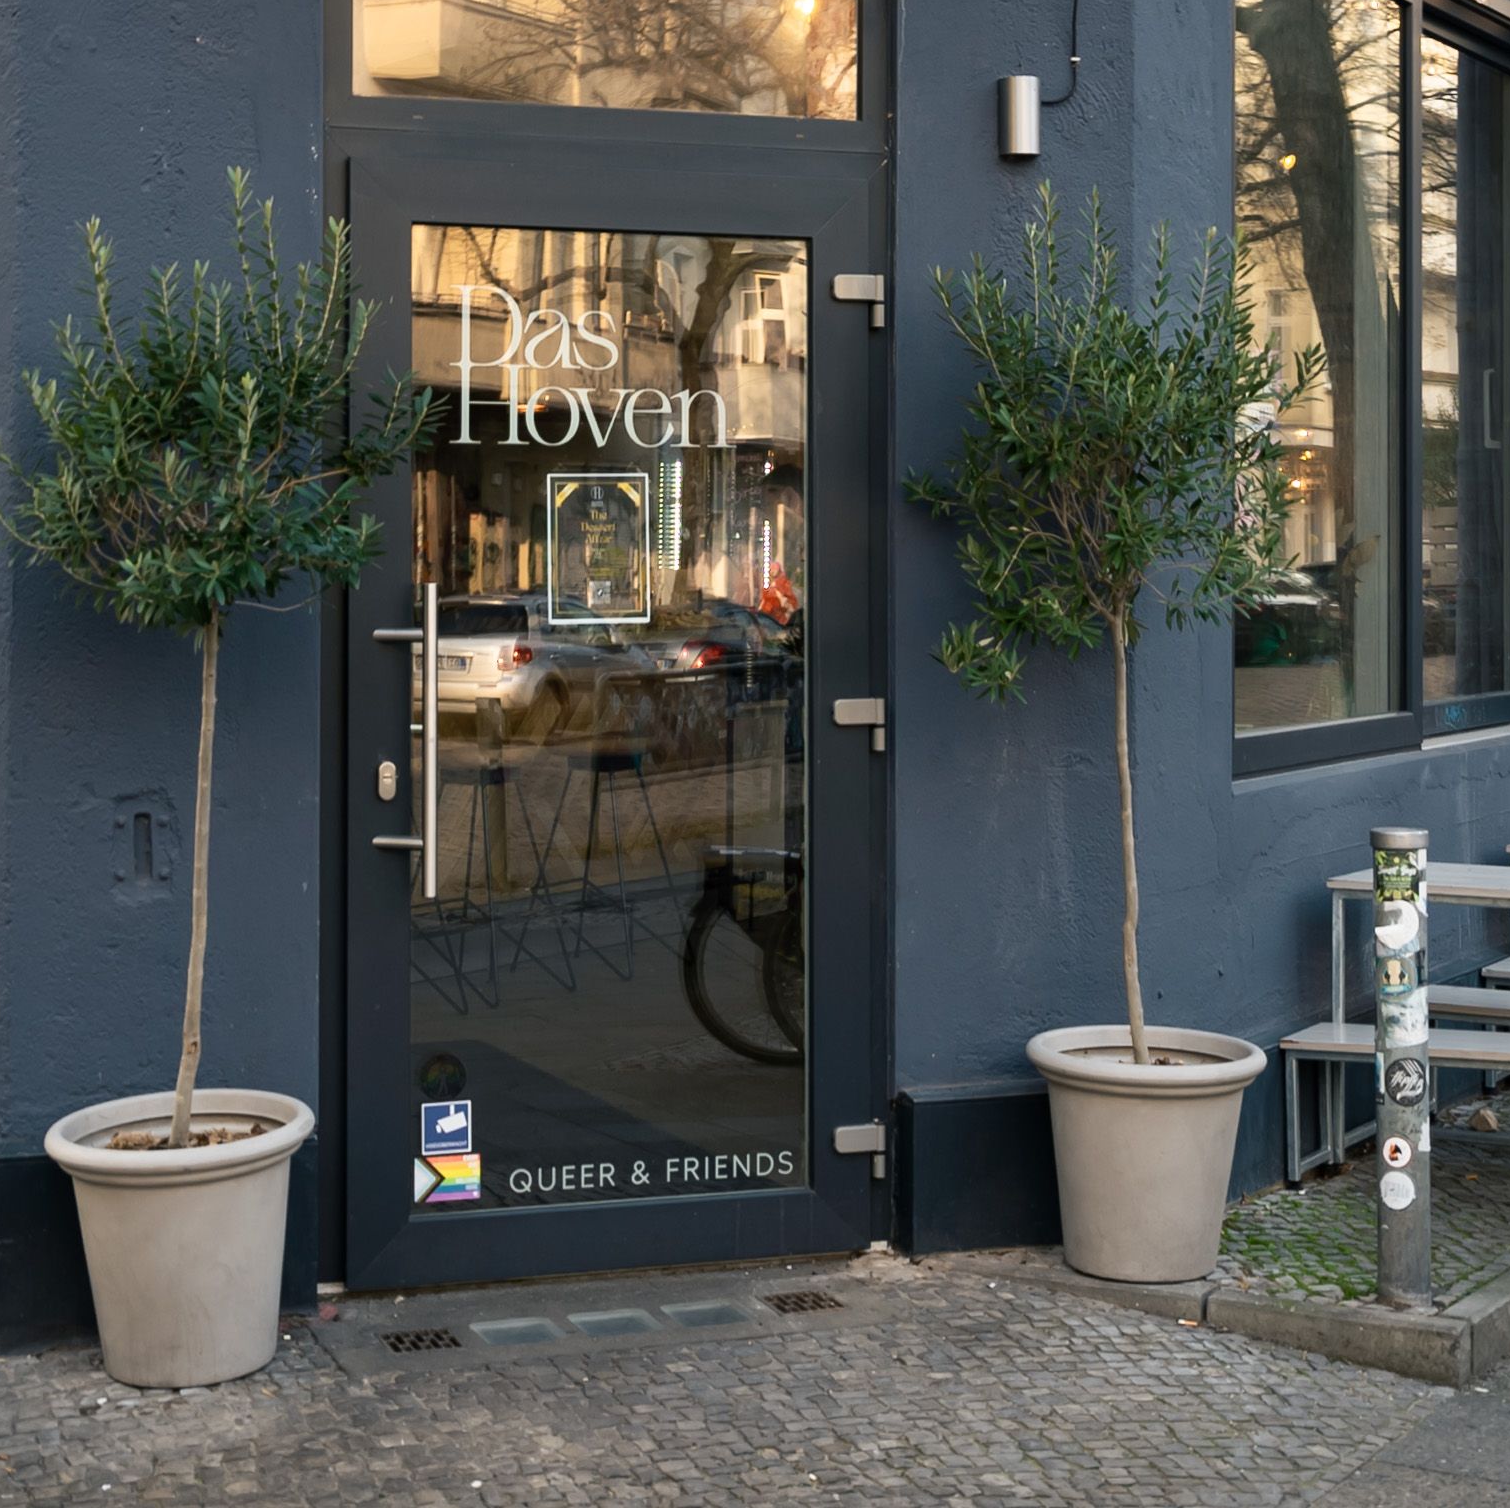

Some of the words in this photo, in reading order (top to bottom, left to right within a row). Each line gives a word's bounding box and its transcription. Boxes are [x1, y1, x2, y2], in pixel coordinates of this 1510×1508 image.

[449, 284, 619, 371] Das
[448, 363, 738, 449] Hoven
[509, 1161, 616, 1193] QUEER
[631, 1160, 650, 1185] &
[666, 1150, 794, 1183] FRIENDS
